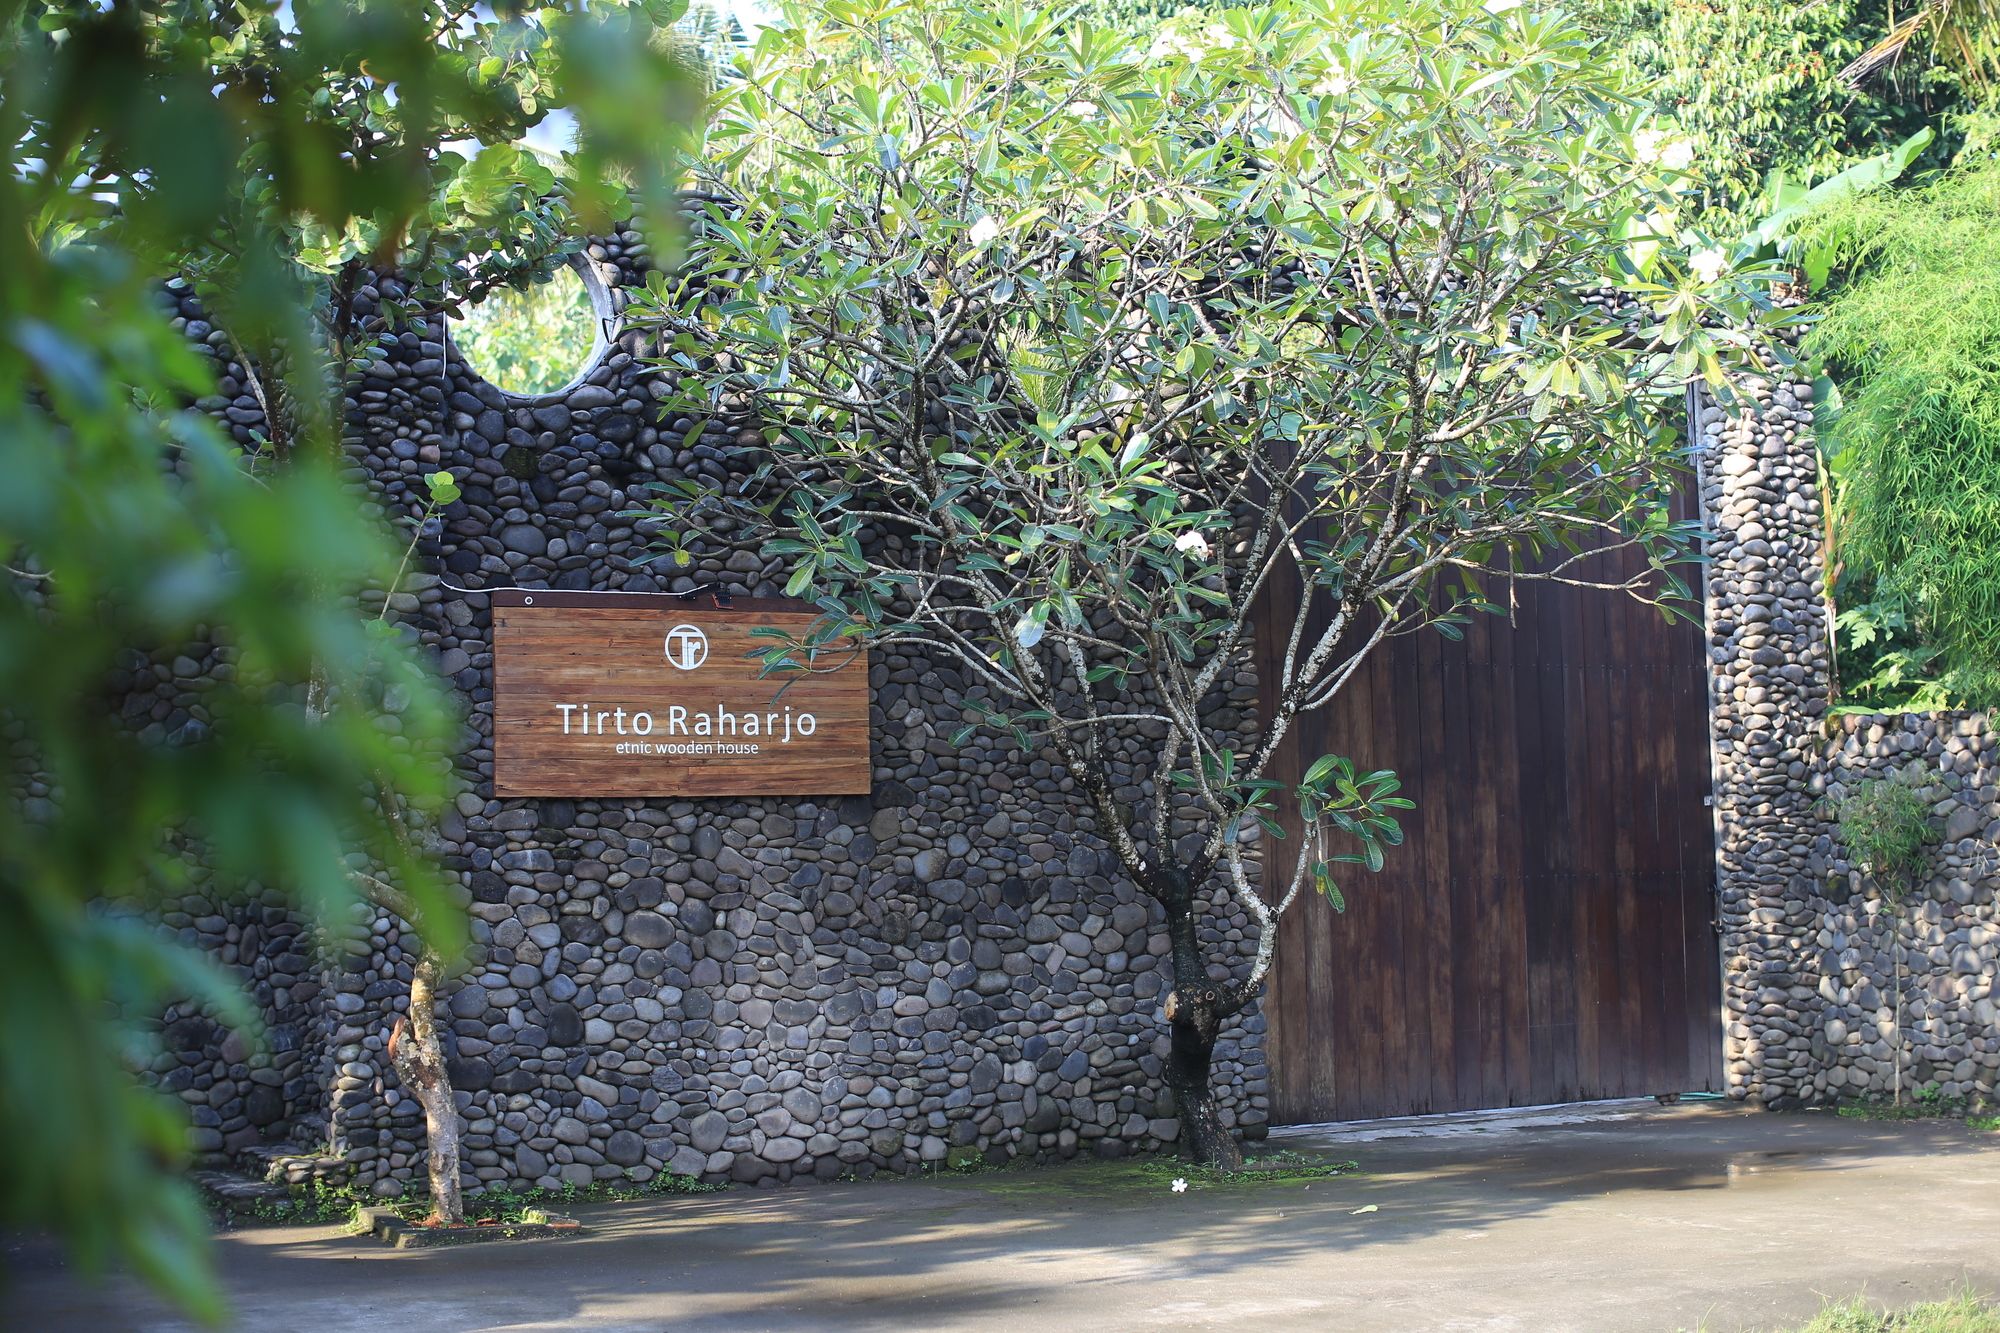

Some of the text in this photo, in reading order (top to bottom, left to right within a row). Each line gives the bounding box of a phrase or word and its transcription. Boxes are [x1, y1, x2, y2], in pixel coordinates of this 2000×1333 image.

[555, 703, 816, 743] Tirto Raharjo
[615, 740, 759, 755] etnic wooden house
